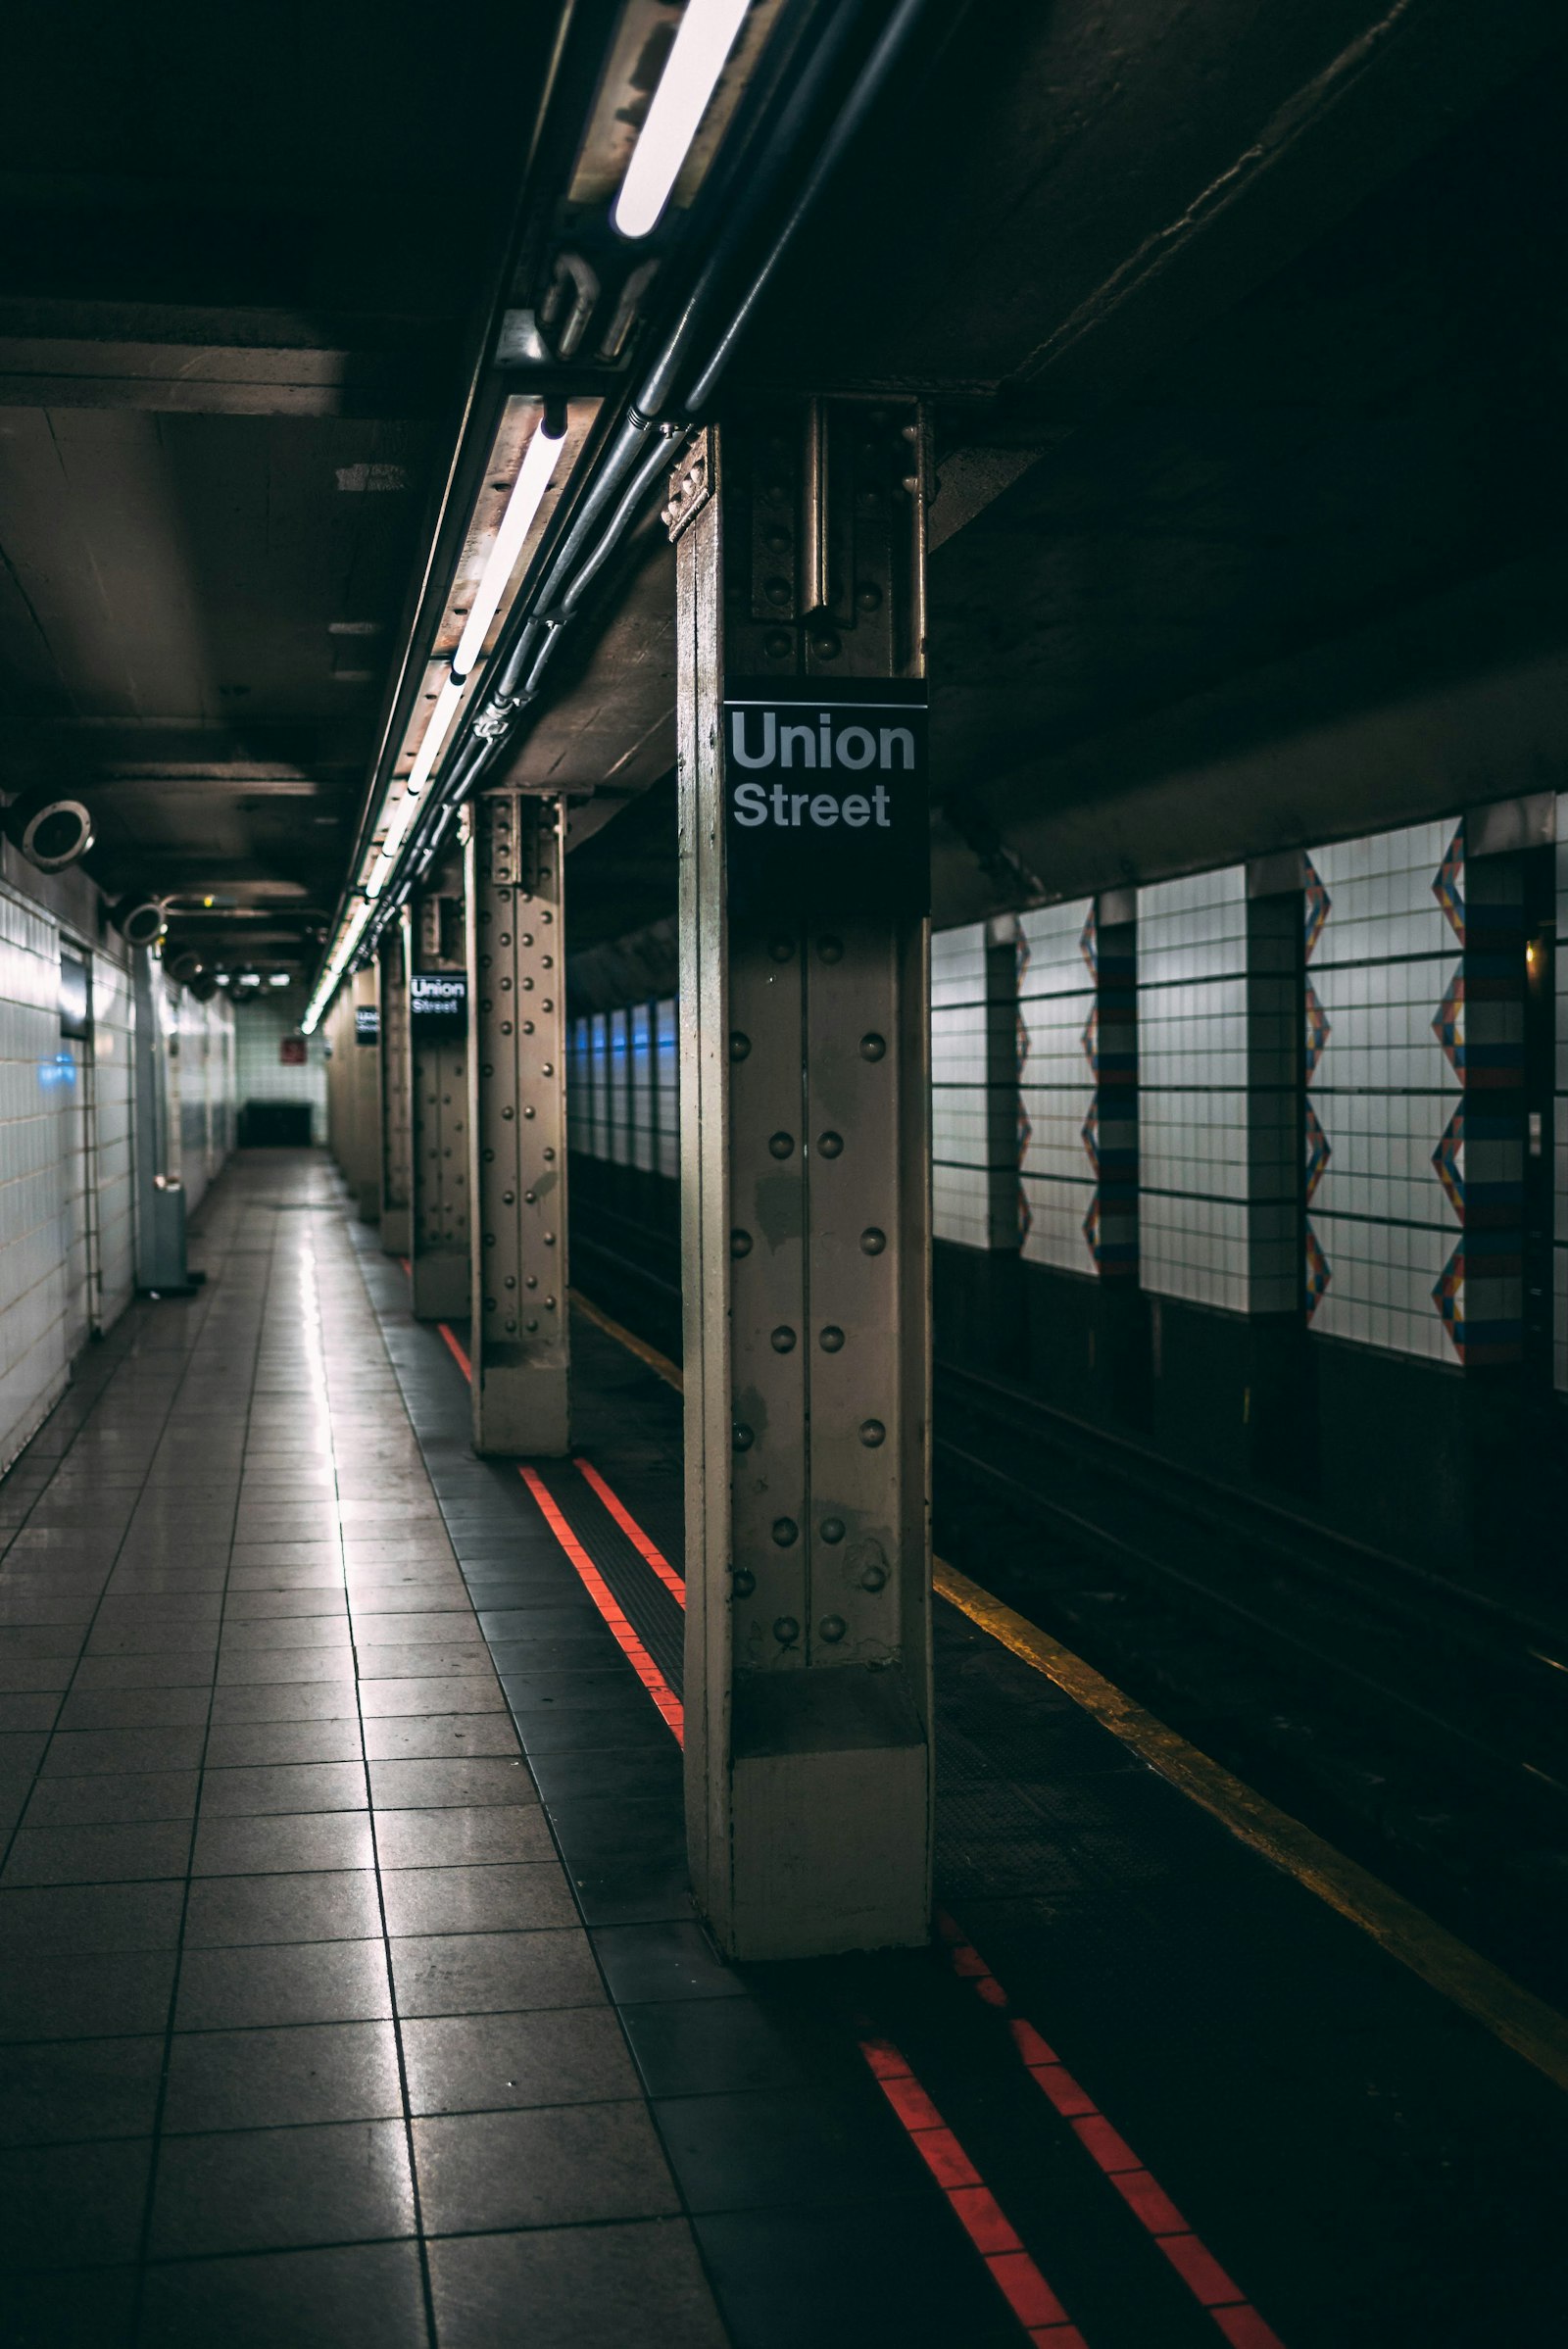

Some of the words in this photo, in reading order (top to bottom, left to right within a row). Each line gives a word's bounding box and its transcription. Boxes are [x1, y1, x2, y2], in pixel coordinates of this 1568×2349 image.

[732, 711, 914, 769] Union
[734, 783, 891, 827] Street
[412, 979, 465, 997] Union
[412, 999, 457, 1013] Street
